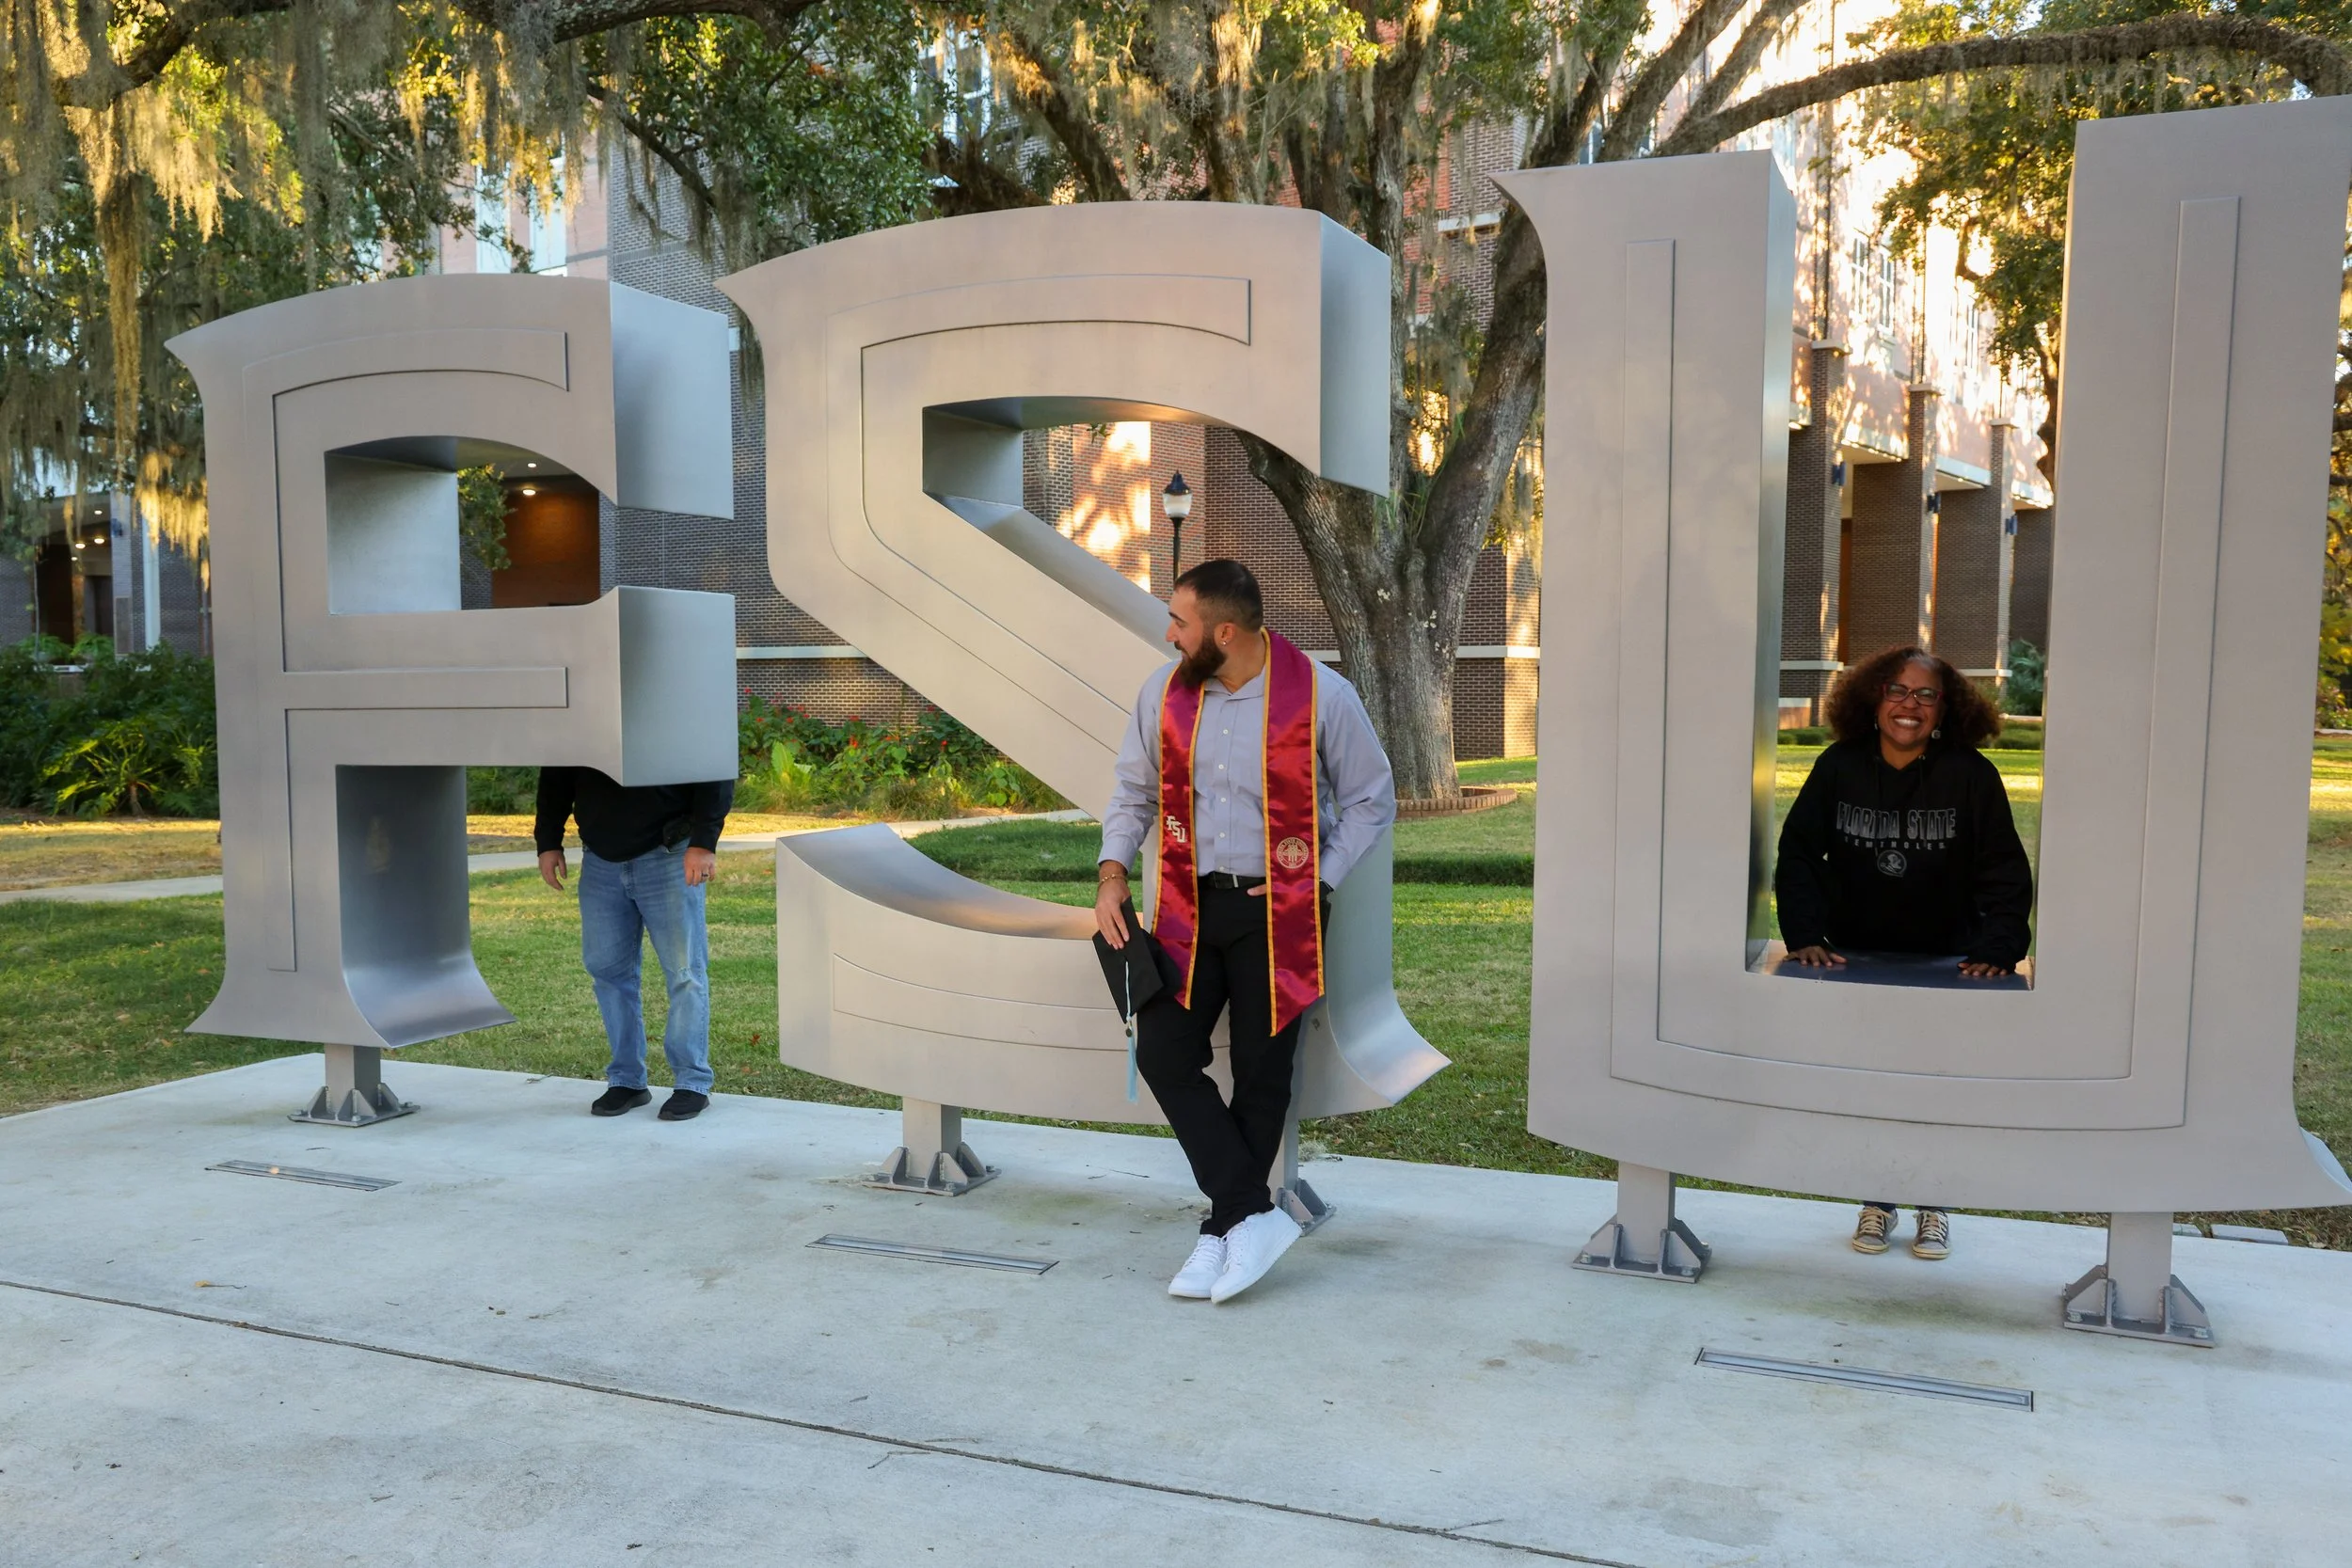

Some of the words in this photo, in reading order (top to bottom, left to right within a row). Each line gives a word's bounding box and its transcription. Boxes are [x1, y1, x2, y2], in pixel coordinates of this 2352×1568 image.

[1166, 815, 1187, 844] FSU
[1836, 800, 1900, 839] FLORIDA
[1907, 808, 1957, 840] STATE
